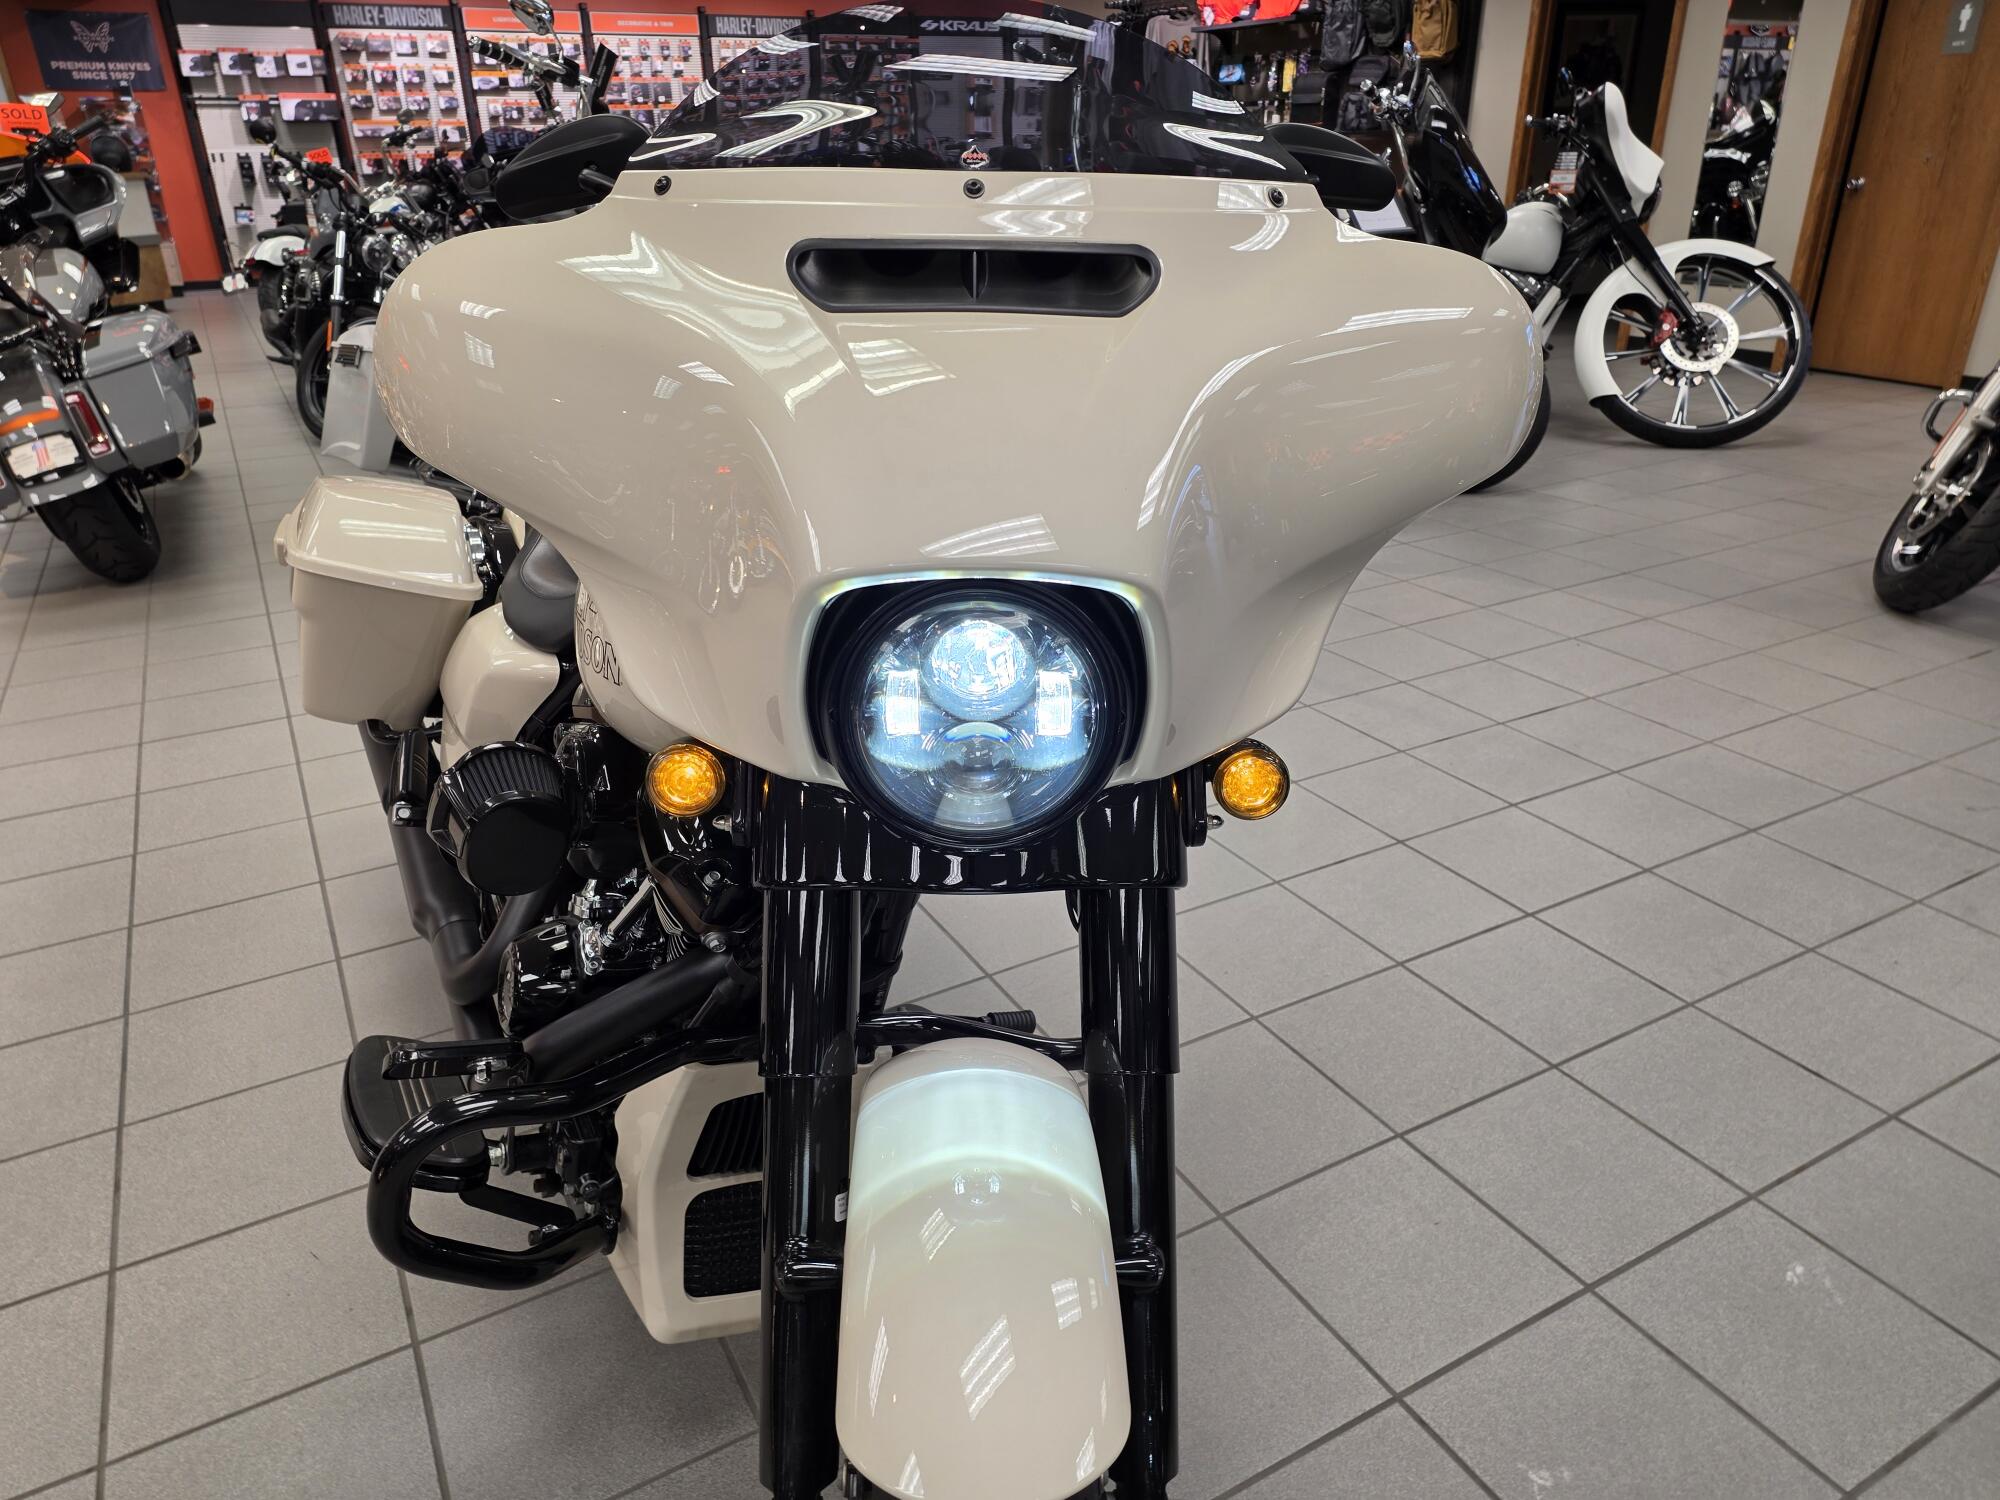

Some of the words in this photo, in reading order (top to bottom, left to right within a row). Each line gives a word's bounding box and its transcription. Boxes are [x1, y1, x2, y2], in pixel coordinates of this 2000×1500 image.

[332, 5, 443, 27] HARLEY-DAVIDSON
[940, 20, 1000, 31] KRAUS
[50, 60, 106, 71] PREMIUM
[108, 62, 151, 71] KNIVES
[72, 71, 108, 80] SINCE
[110, 71, 136, 81] 1987
[1, 107, 42, 120] SOLD
